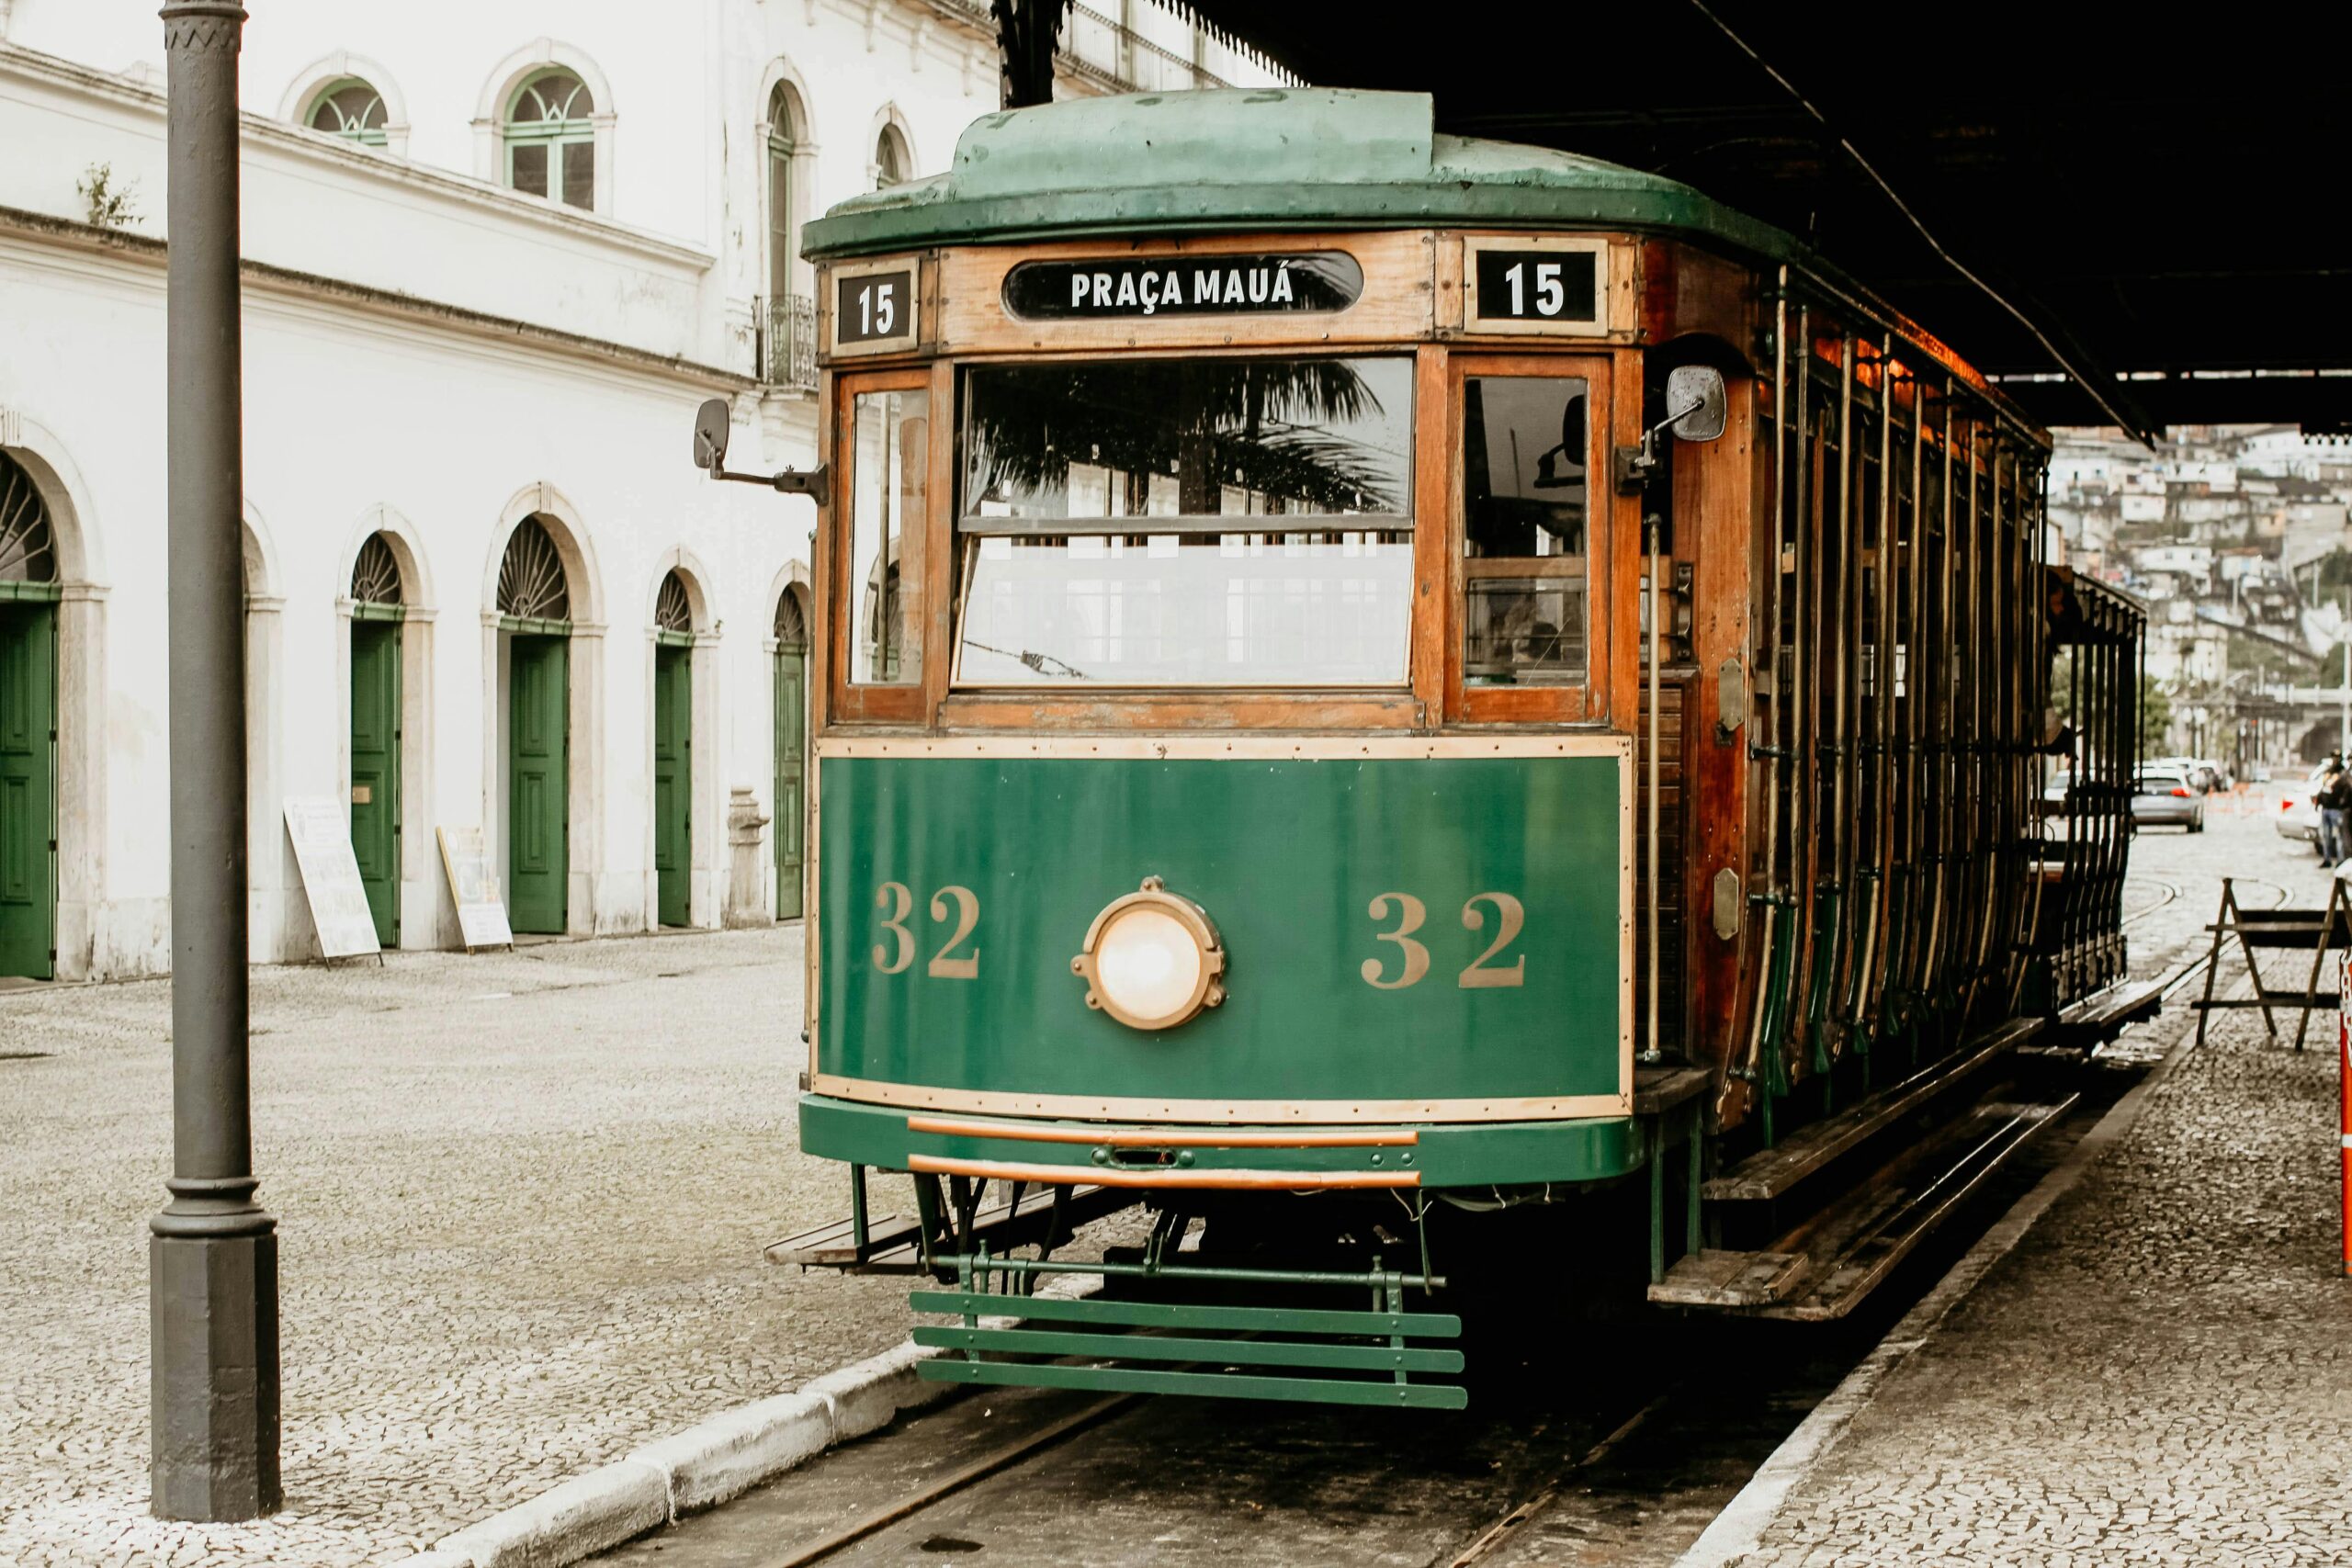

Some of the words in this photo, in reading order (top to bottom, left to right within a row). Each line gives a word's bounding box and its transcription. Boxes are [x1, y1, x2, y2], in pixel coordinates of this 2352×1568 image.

[859, 283, 894, 335] 15
[1071, 271, 1183, 315] PRAÇA
[1193, 260, 1295, 304] MAUÁ
[1504, 263, 1564, 316] 15
[872, 881, 980, 979] 32
[1361, 892, 1526, 989] 32
